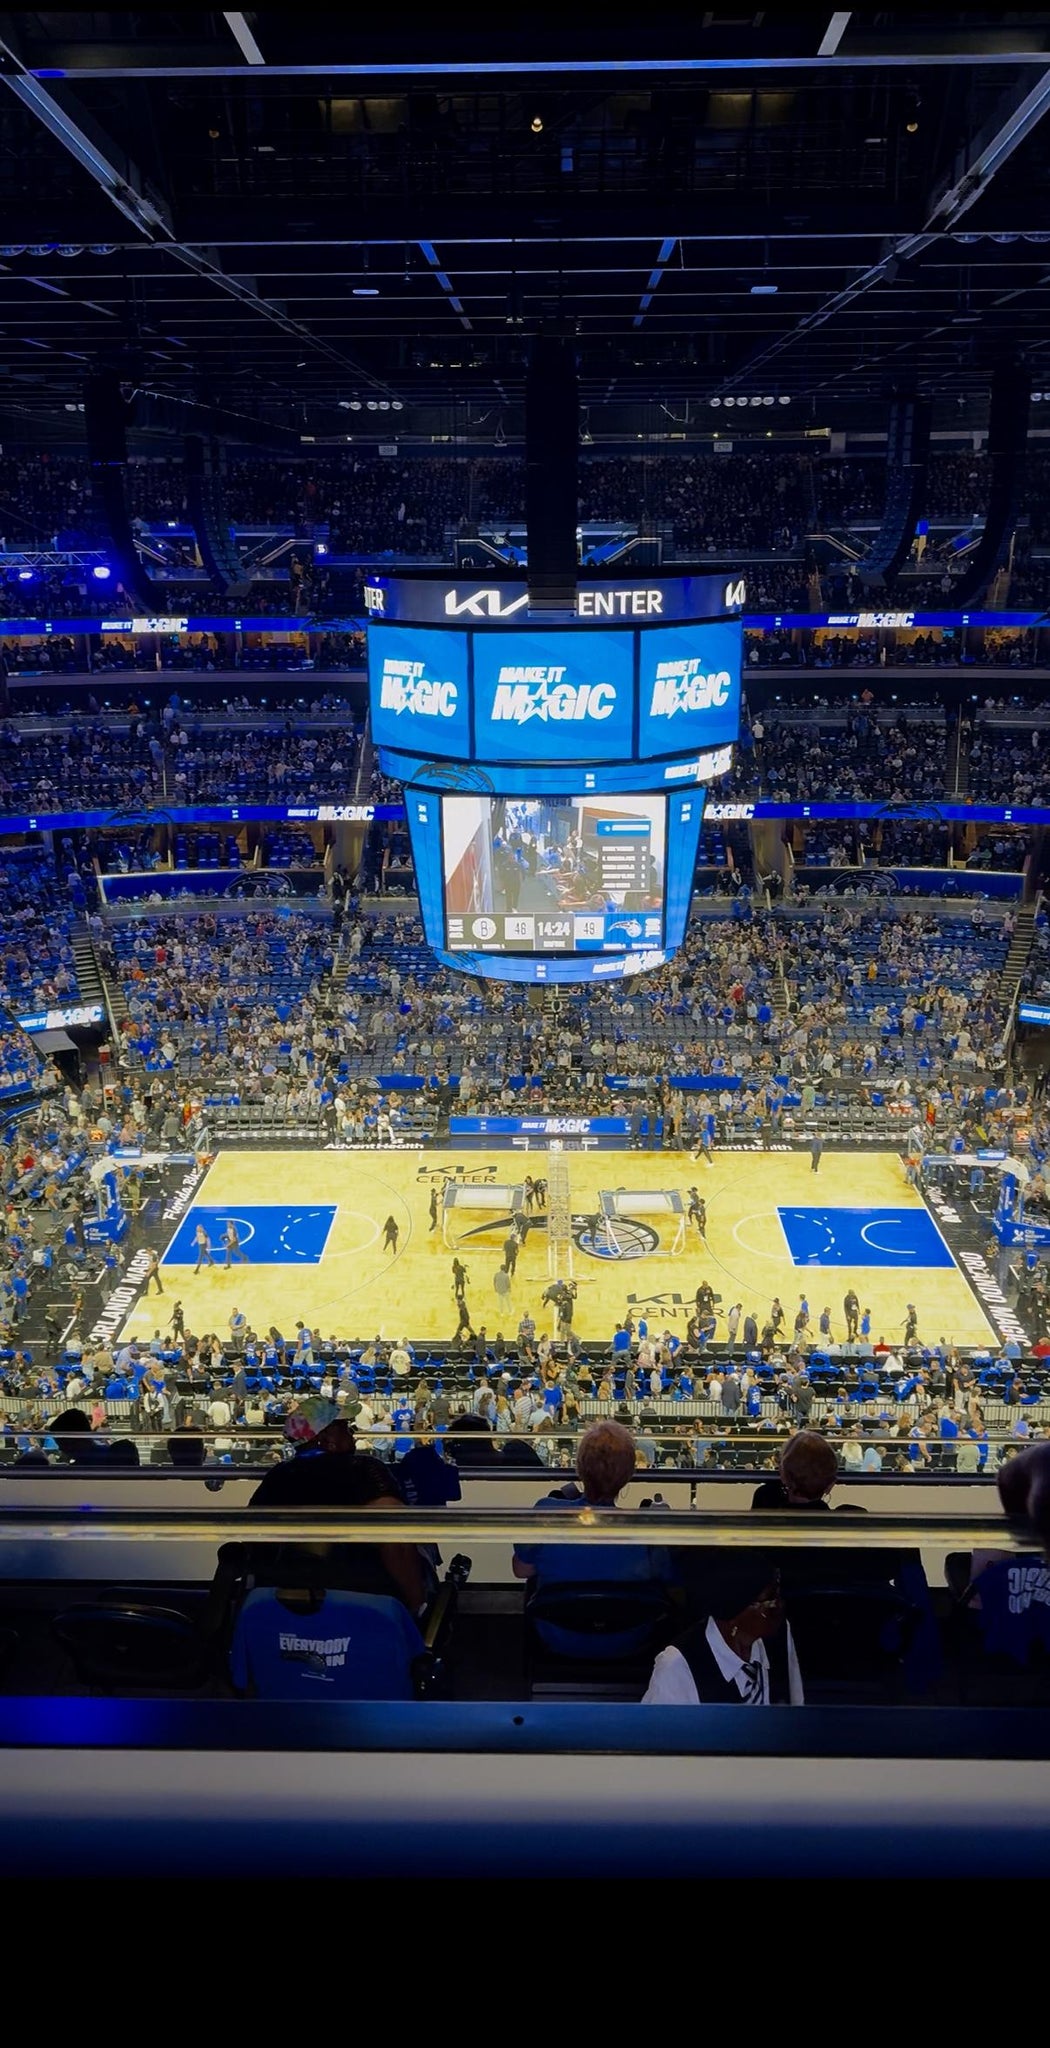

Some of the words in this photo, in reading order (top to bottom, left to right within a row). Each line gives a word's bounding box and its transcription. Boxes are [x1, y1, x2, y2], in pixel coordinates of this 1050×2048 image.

[578, 590, 663, 616] ENTER
[499, 666, 546, 684] MAKE
[545, 666, 568, 683] IT
[379, 675, 458, 717] MAGIC
[490, 677, 617, 725] MAGIC
[649, 670, 731, 720] MAGIC
[537, 922, 570, 937] 14:24
[544, 1118, 591, 1133] MAGIC
[415, 1175, 497, 1184] CENTER
[161, 1185, 194, 1220] Florida
[958, 1251, 1008, 1304] ORLANDO
[88, 1286, 137, 1342] ORLANDO
[628, 1307, 727, 1319] CENTR
[279, 1636, 351, 1654] EVERYBODY
[325, 1653, 346, 1667] IN
